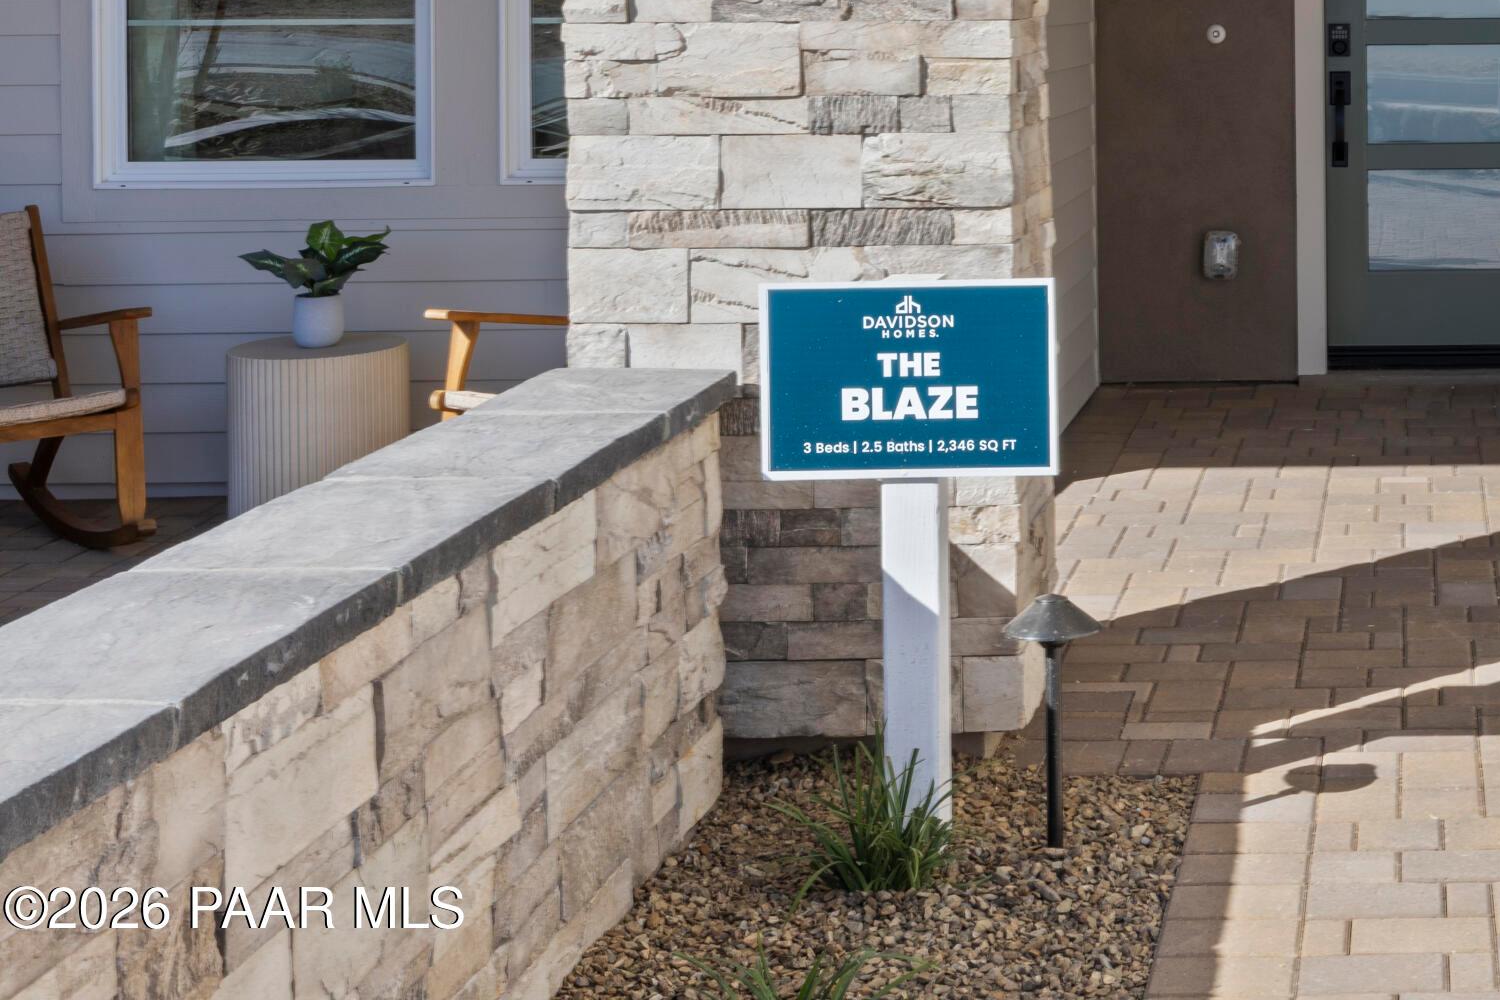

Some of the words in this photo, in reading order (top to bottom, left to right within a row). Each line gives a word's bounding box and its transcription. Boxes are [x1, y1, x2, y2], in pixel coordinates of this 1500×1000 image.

[862, 314, 954, 329] DAVIDSON
[876, 352, 941, 378] THE
[841, 385, 979, 421] BLAZE
[803, 442, 812, 454] 3
[816, 441, 850, 454] Beds
[861, 441, 883, 453] 2.5
[886, 440, 925, 453] Baths
[937, 440, 975, 453] 2,346
[979, 439, 999, 453] SQ
[1003, 439, 1017, 451] FT
